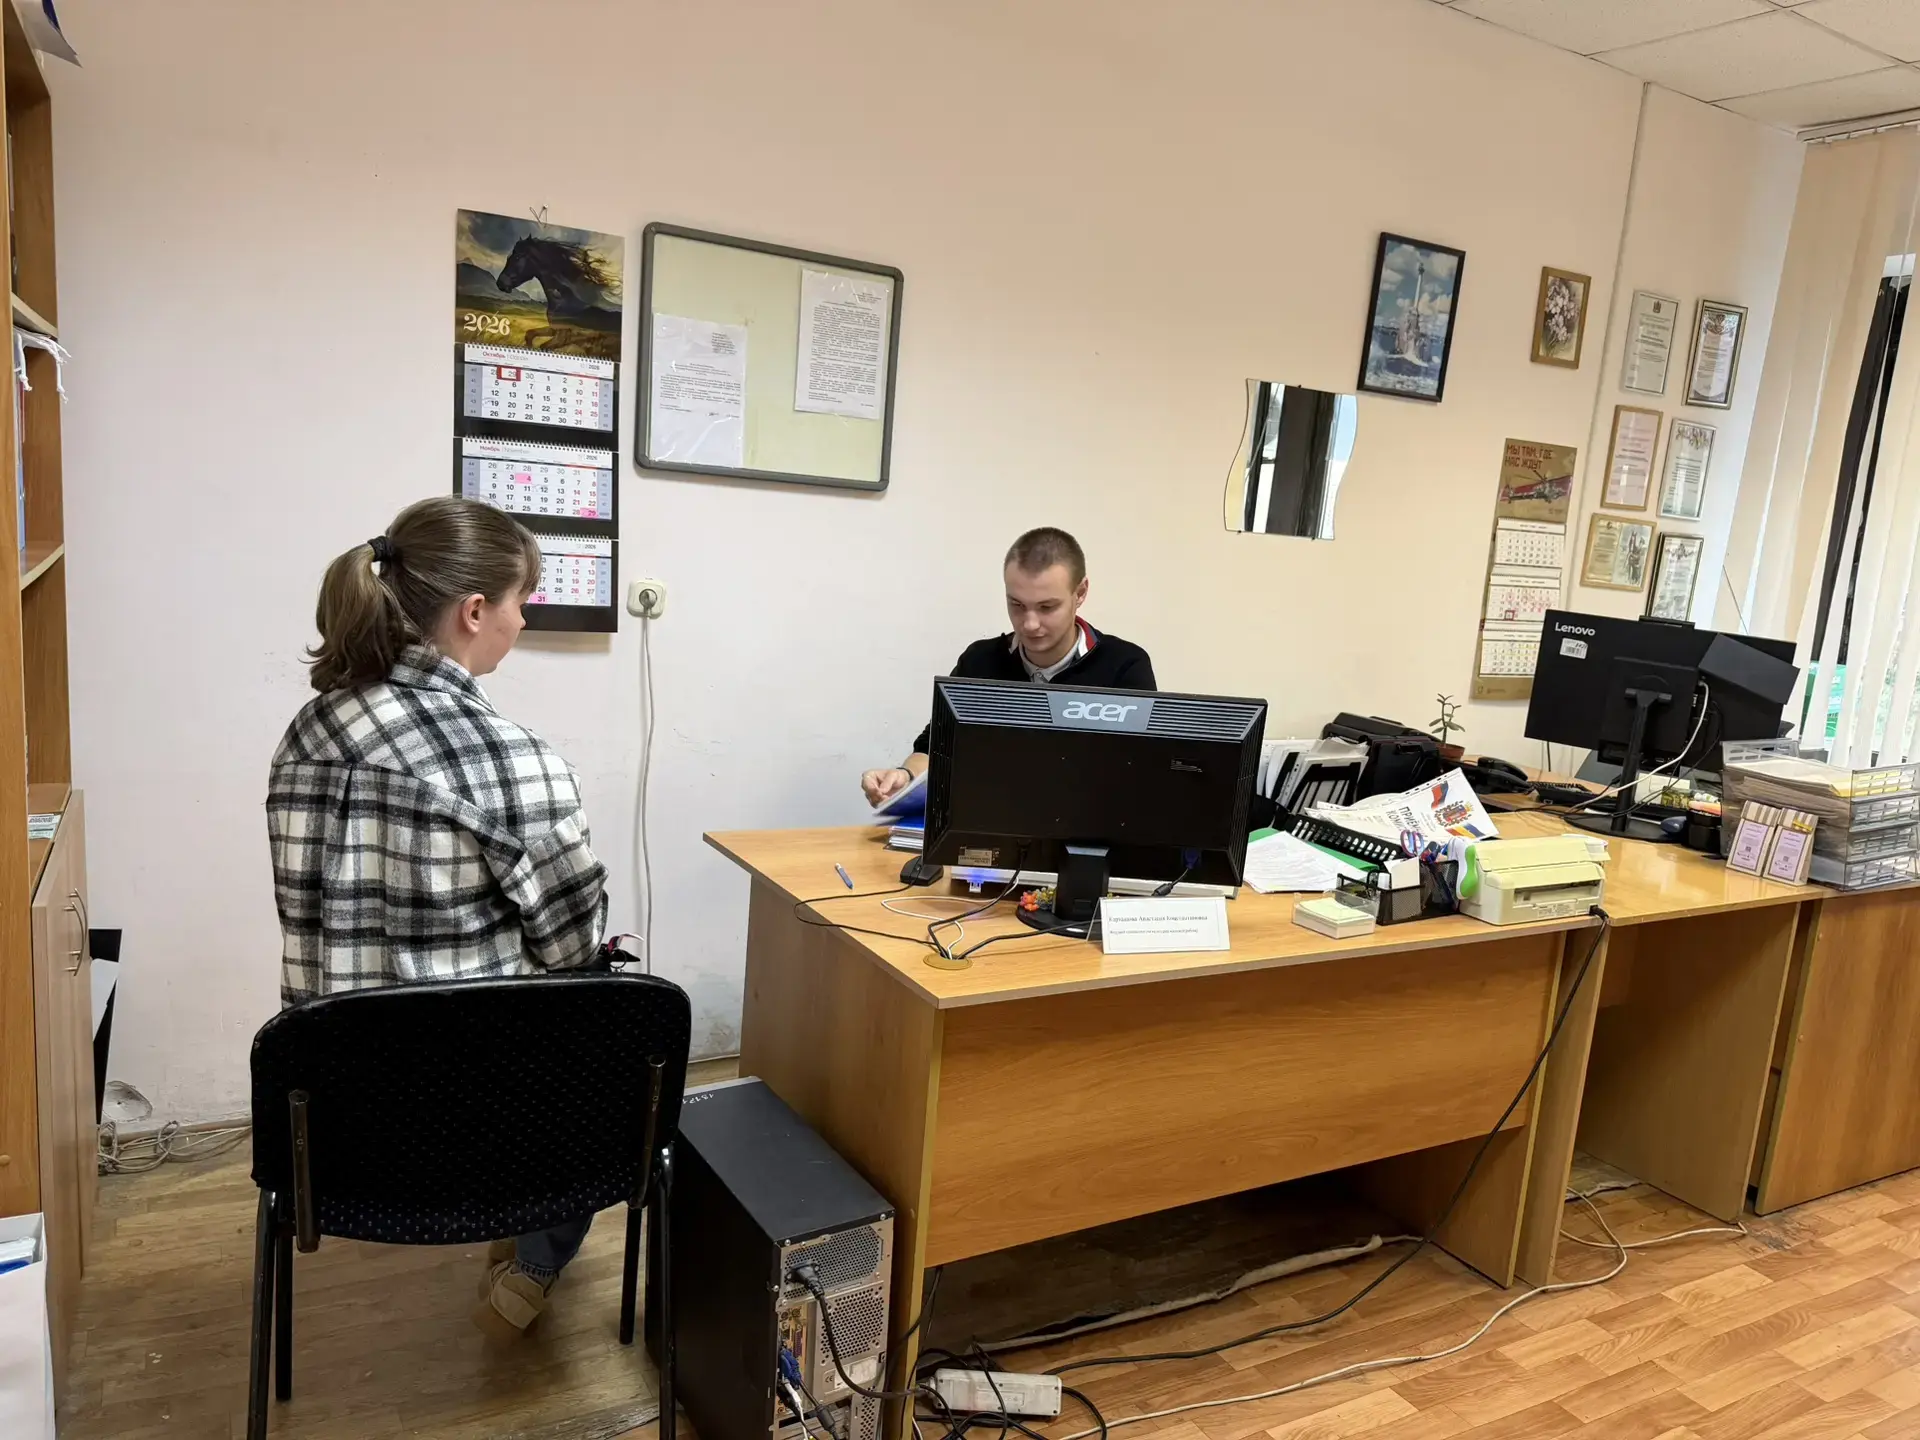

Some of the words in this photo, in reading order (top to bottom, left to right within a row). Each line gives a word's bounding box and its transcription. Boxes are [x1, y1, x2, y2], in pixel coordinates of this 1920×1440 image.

[464, 312, 511, 336] 2026
[1554, 622, 1596, 636] Lenovo
[1062, 700, 1138, 723] acer
